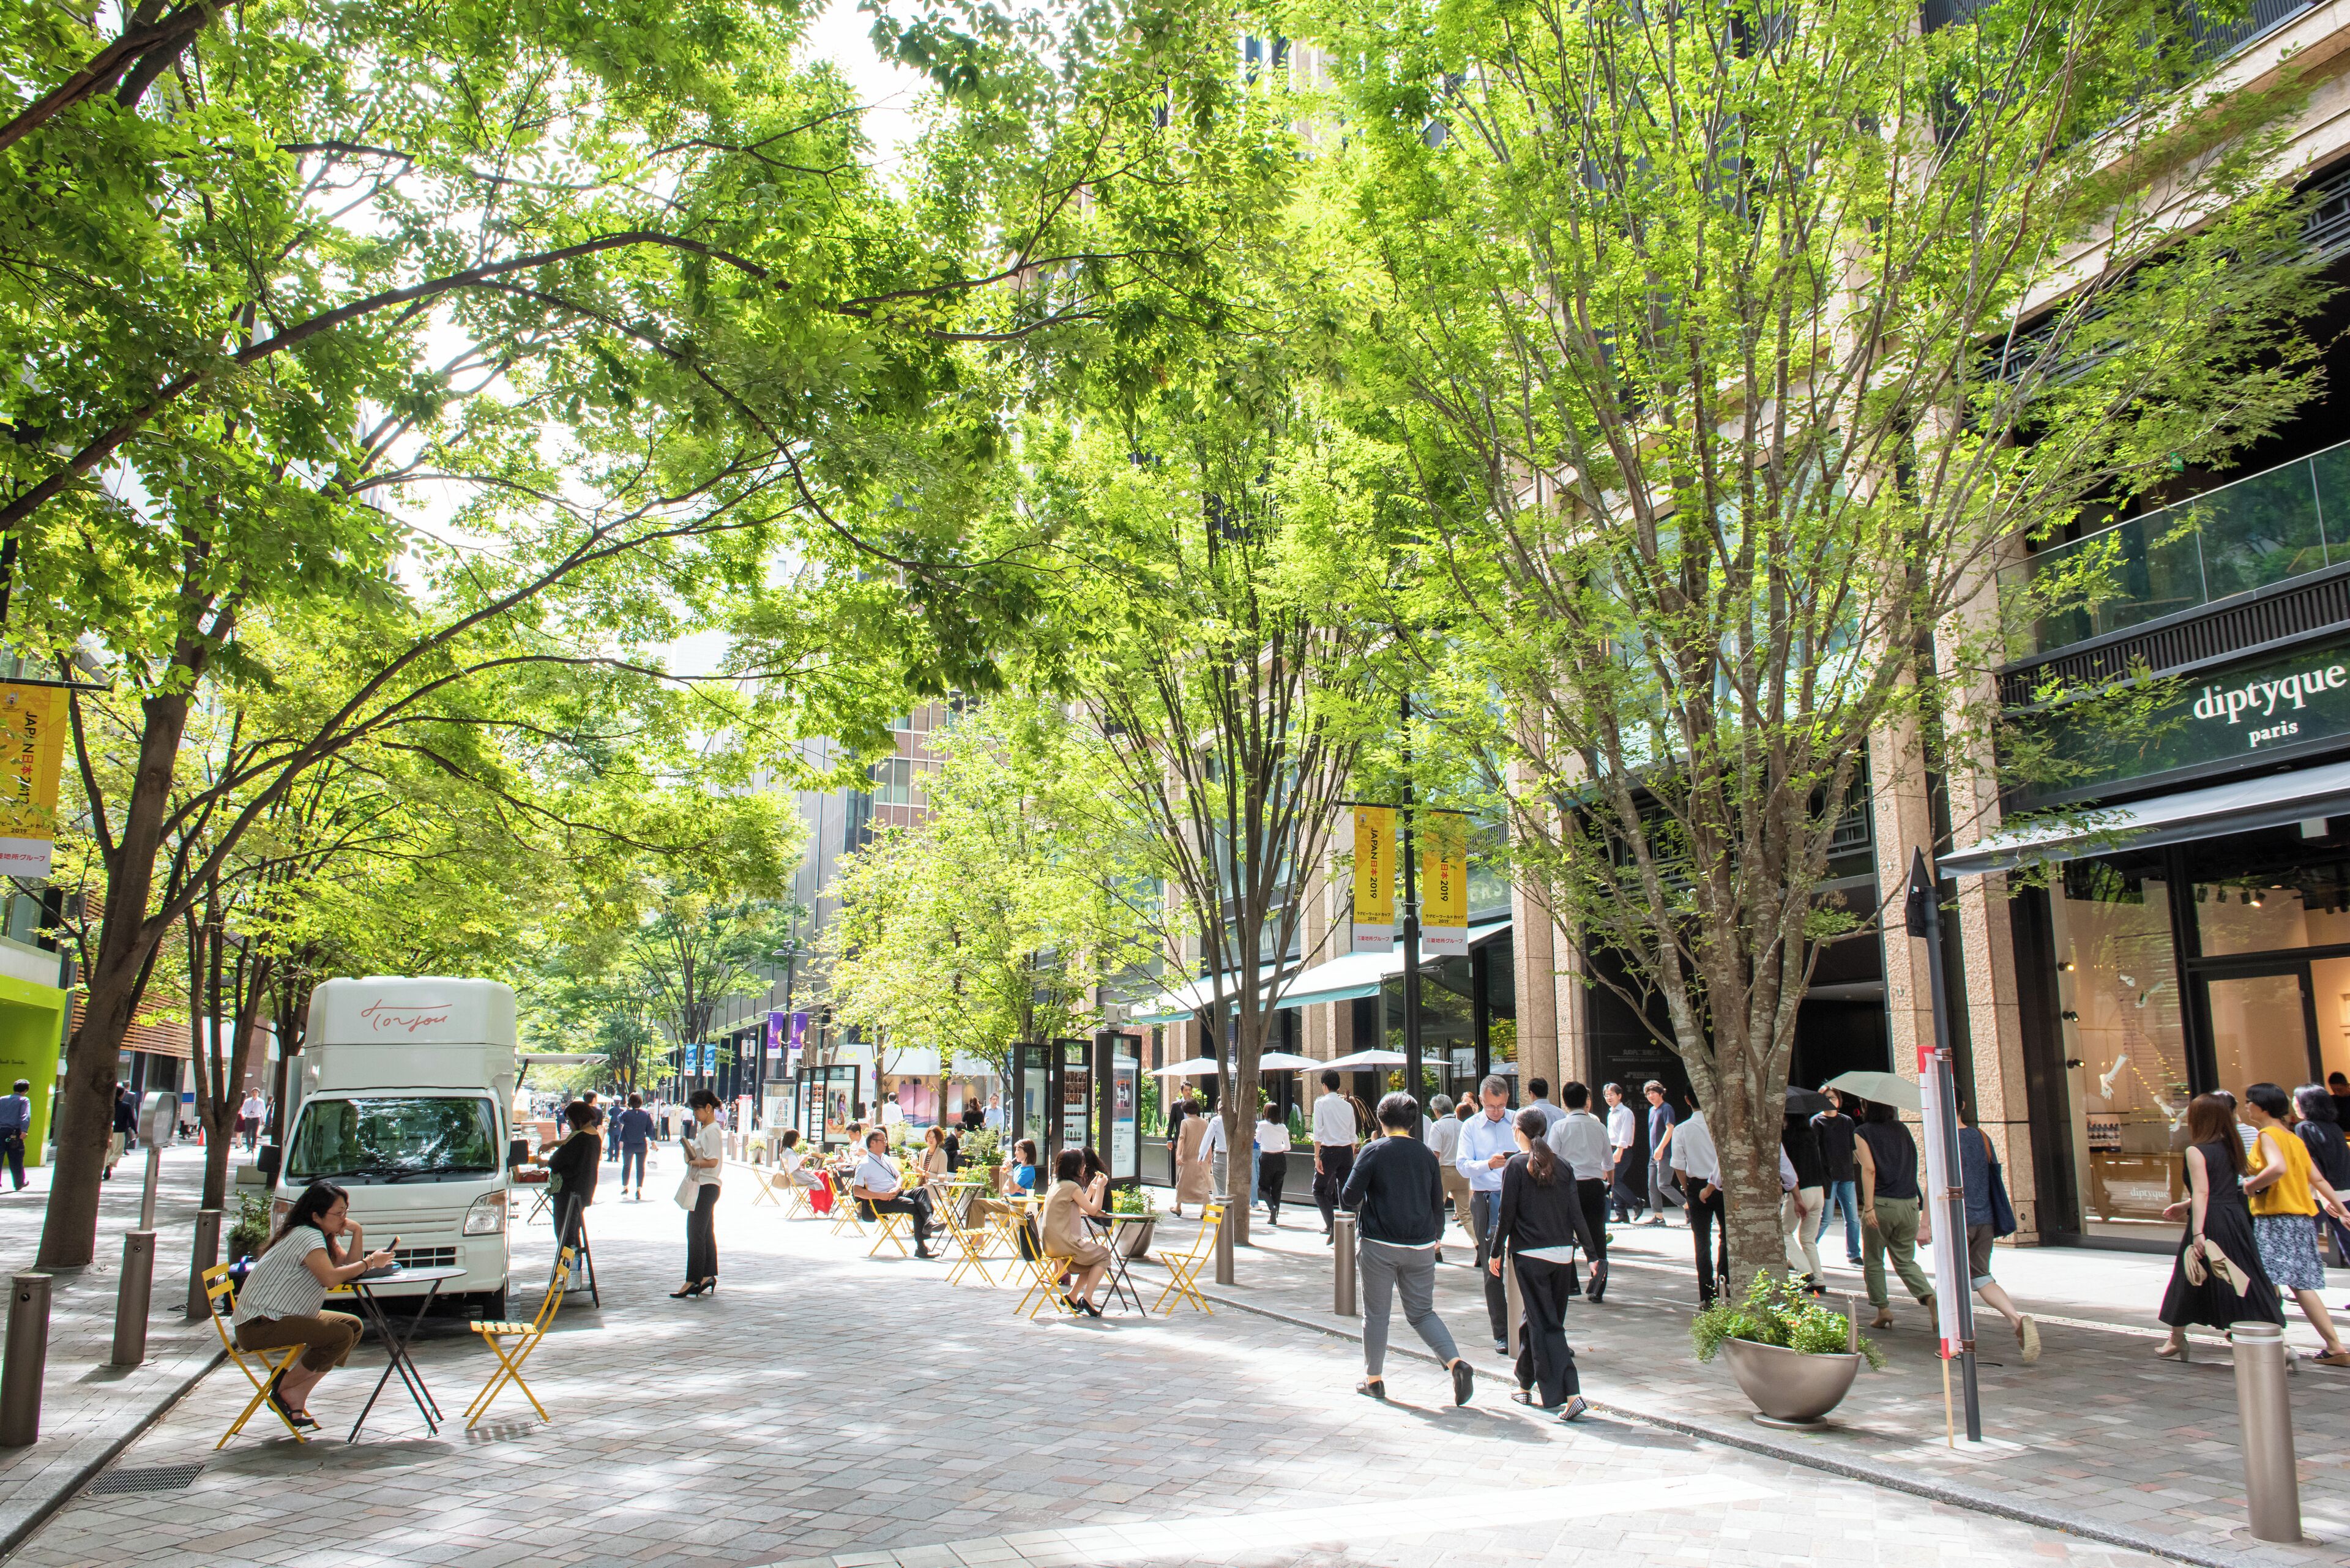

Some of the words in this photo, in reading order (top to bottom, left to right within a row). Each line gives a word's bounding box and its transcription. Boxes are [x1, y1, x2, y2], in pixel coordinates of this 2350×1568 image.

[2193, 665, 2348, 725] diptyque
[2248, 720, 2299, 749] paris
[2130, 1187, 2169, 1201] diptyque
